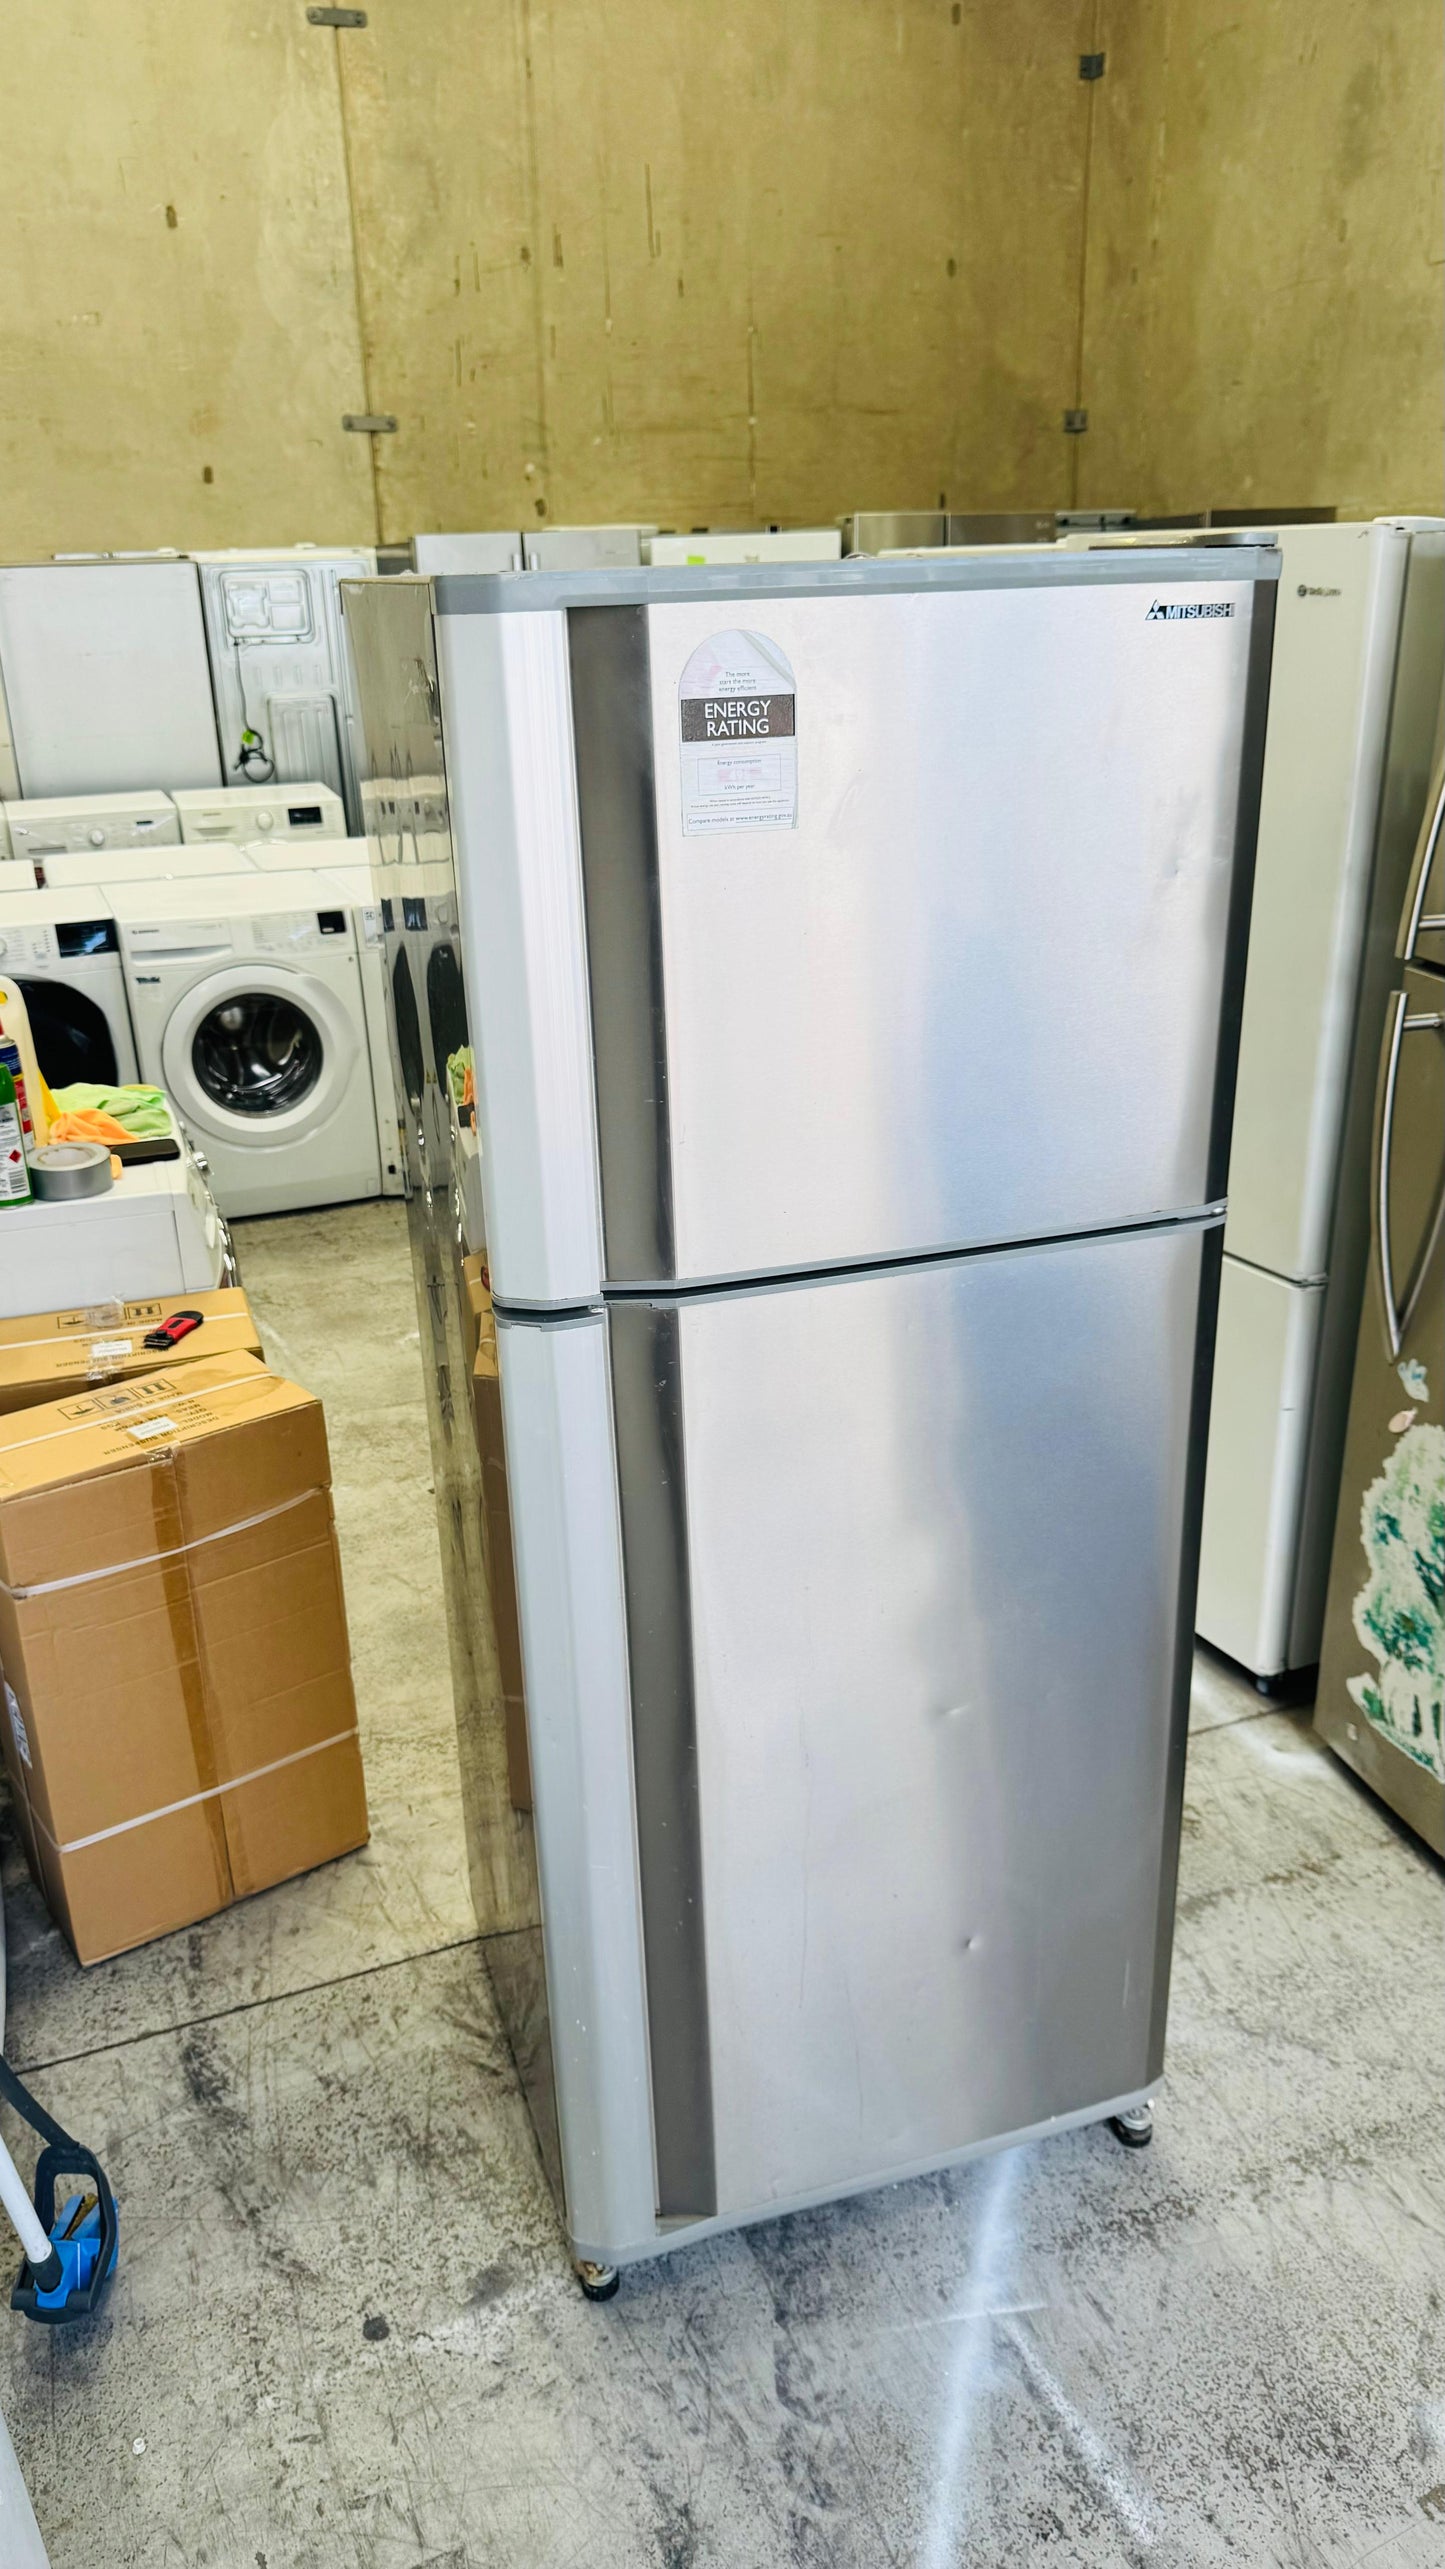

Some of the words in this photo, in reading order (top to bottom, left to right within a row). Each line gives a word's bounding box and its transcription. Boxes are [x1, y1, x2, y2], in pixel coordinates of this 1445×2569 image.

[704, 699, 771, 719] ENERGY
[706, 719, 770, 737] RATING
[717, 759, 732, 767] Energy
[733, 758, 762, 766] consumption
[688, 817, 711, 825] Compare
